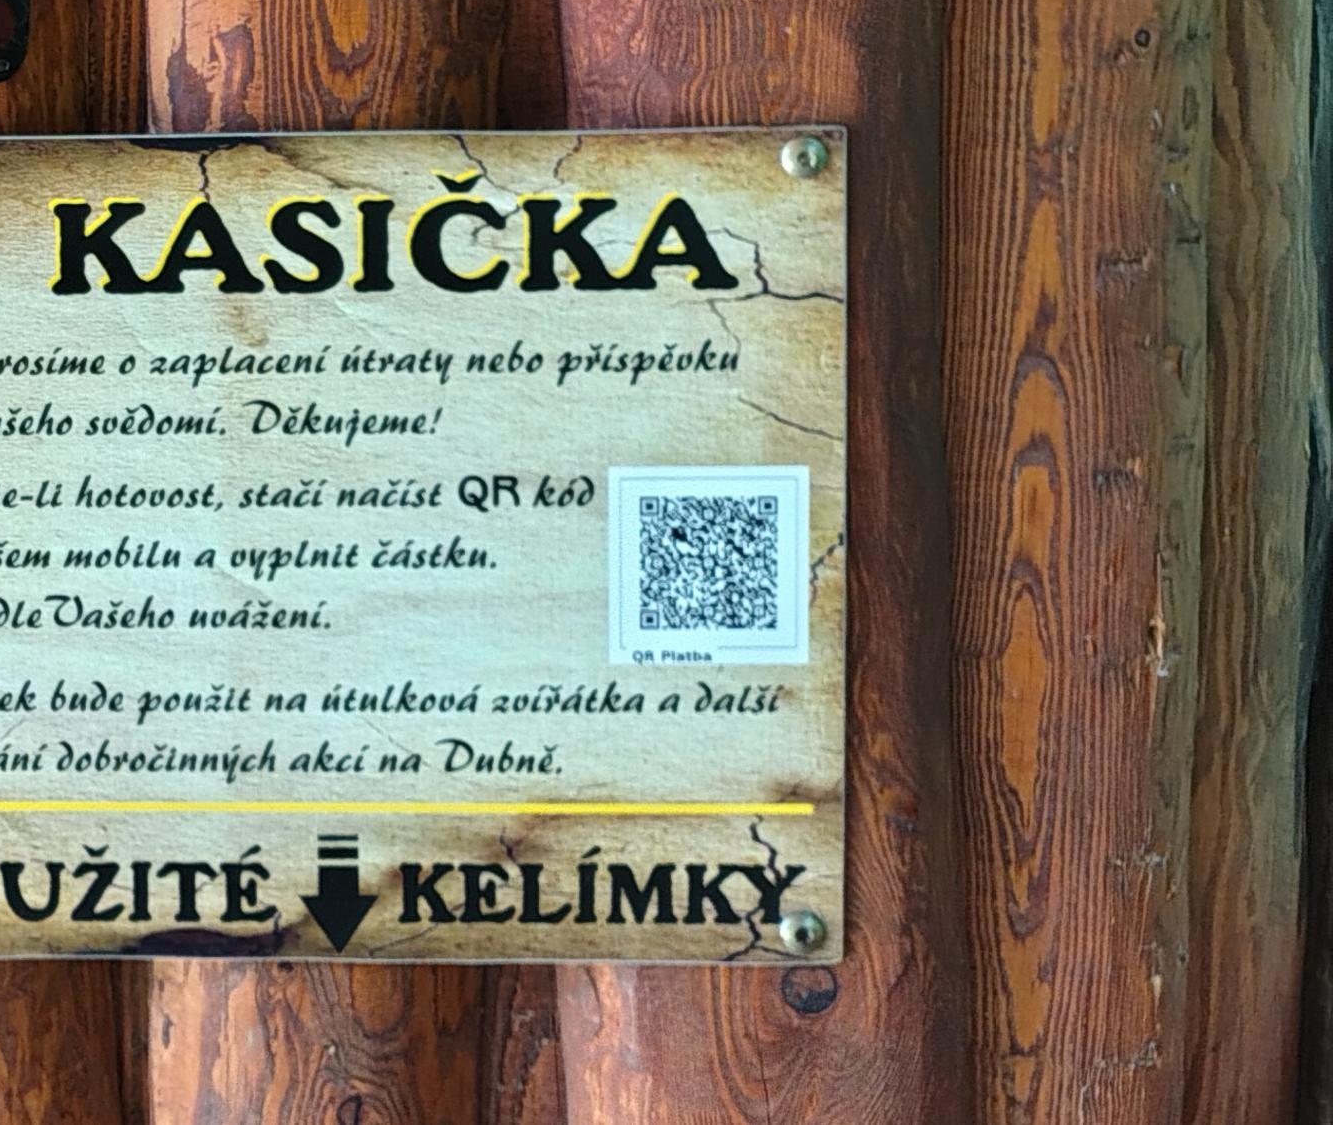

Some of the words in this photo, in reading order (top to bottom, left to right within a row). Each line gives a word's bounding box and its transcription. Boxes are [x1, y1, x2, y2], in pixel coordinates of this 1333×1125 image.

[49, 169, 740, 294] KASIČKA
[119, 356, 136, 375] o
[149, 346, 326, 388] zaplacení
[341, 343, 453, 385] útraty
[466, 339, 544, 374] nebo
[557, 339, 740, 386] příspěvku
[84, 403, 227, 437] svědomí.
[243, 399, 443, 448] Děkujeme!
[75, 475, 224, 513] hotovost,
[237, 477, 324, 509] stačí
[336, 477, 443, 508] načíst
[457, 475, 521, 512] QR
[533, 475, 595, 508] kód
[62, 534, 182, 568] mobilu
[193, 548, 216, 568] a
[229, 537, 361, 582] vyplnit
[371, 535, 498, 569] částku.
[44, 595, 175, 629] Vašeho
[188, 598, 332, 630] uvážení.
[632, 650, 654, 665] QR
[660, 650, 713, 662] Platba
[49, 679, 125, 713] bude
[137, 680, 251, 724] použit
[262, 693, 308, 713] na
[321, 681, 479, 714] útulková
[491, 681, 645, 714] zvířátka
[657, 694, 679, 713] a
[692, 681, 785, 714] další
[55, 739, 276, 784] dobročinných
[288, 742, 369, 774] akcí
[379, 753, 422, 773] na
[434, 738, 564, 774] Dubně.
[397, 845, 807, 924] KELÍMKY
